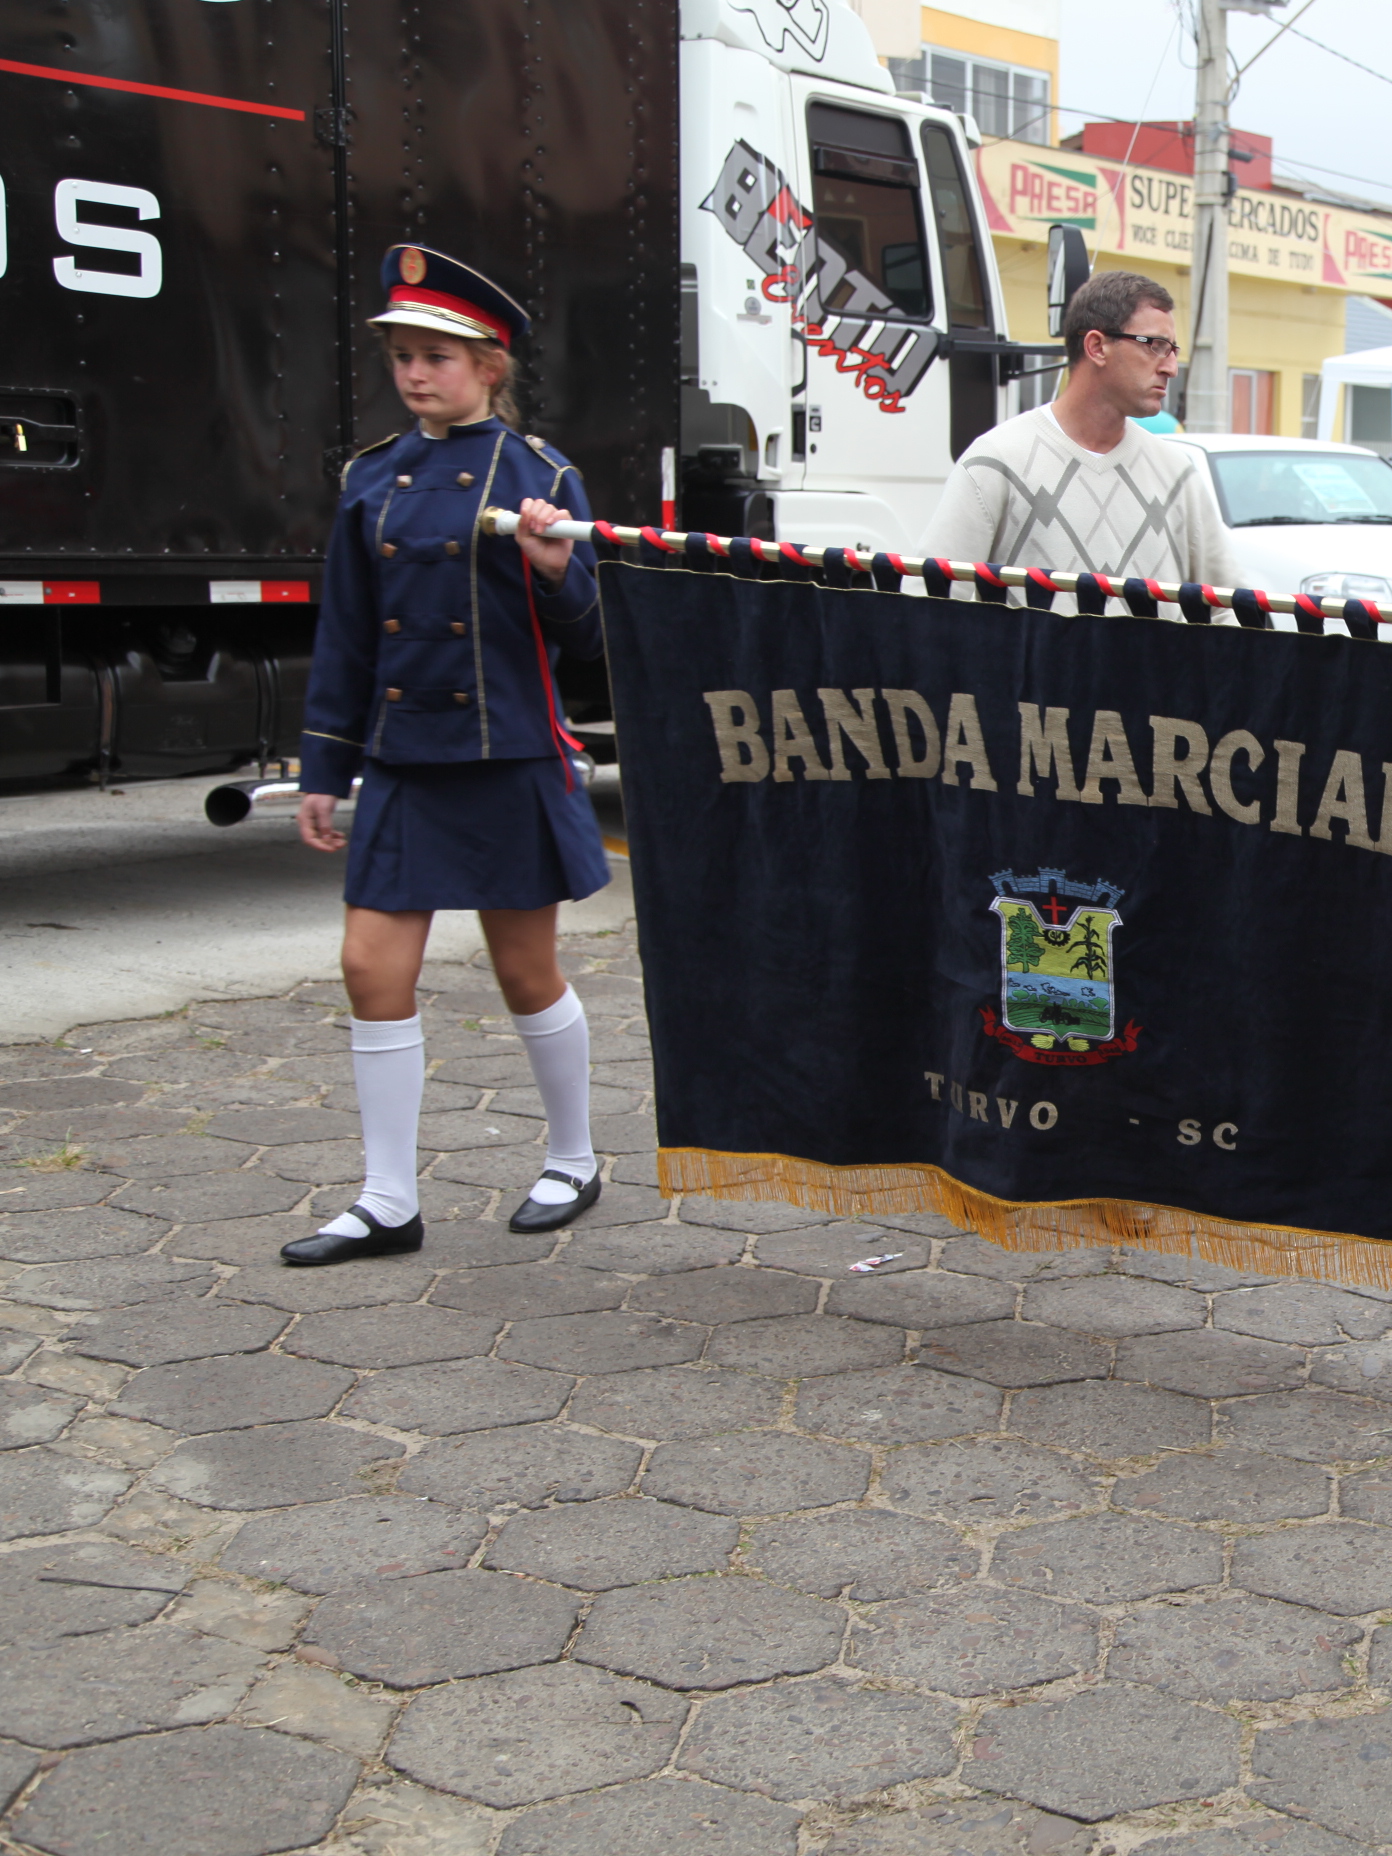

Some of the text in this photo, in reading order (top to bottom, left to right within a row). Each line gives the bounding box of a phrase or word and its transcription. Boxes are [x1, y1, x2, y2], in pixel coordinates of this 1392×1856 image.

[1268, 248, 1280, 266] DE
[703, 687, 998, 792] BANDA
[1035, 1052, 1088, 1063] TURVO
[924, 1071, 1058, 1131] TURVO
[1176, 1119, 1239, 1150] SC
